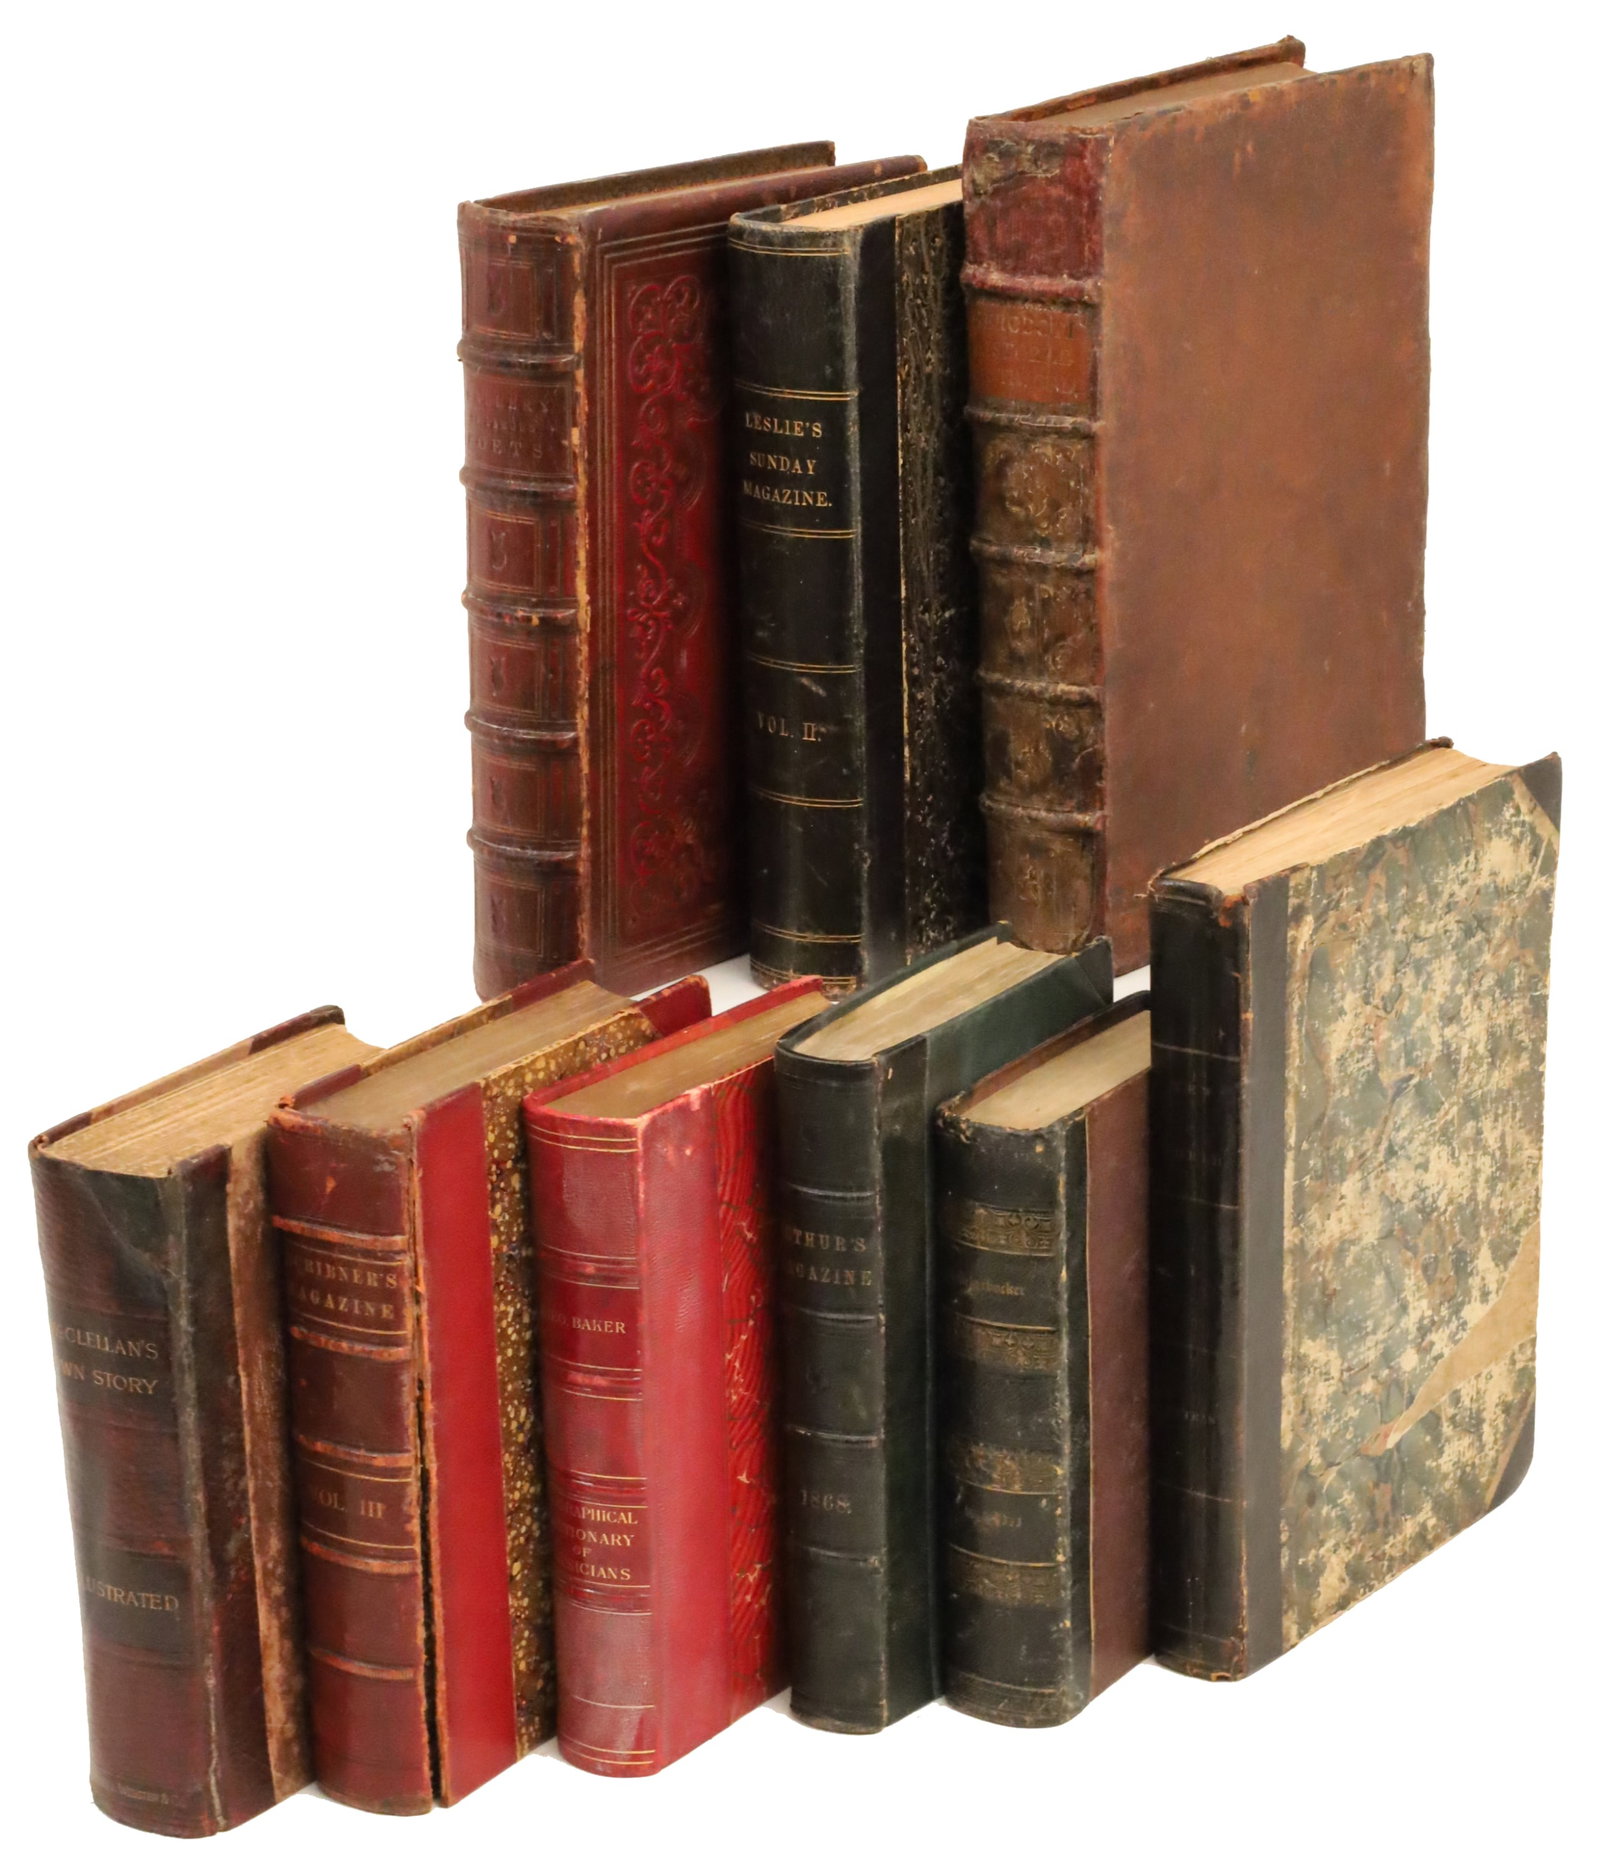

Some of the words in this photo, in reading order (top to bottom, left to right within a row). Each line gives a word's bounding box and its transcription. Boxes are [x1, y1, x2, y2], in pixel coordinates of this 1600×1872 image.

[745, 412, 823, 438] LESLIE'S
[749, 452, 816, 474] SUNDAY
[743, 480, 833, 507] MAGAZINE.
[571, 1316, 626, 1334] BAKER
[93, 1369, 158, 1395] STORY
[360, 1499, 385, 1519] III
